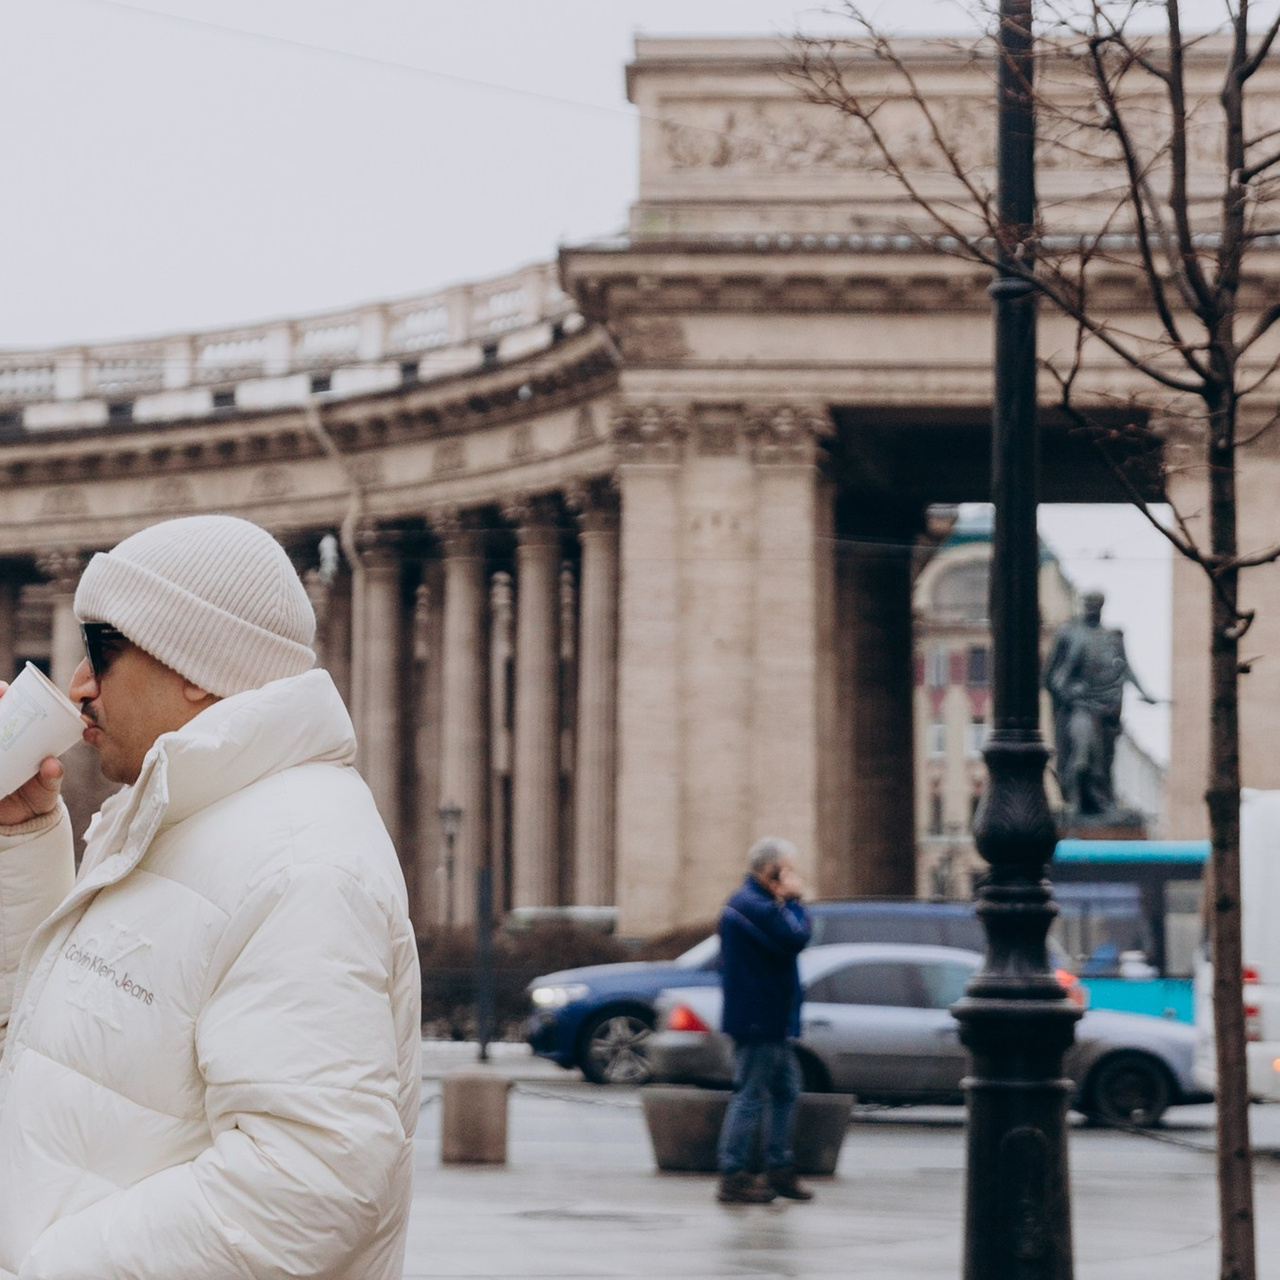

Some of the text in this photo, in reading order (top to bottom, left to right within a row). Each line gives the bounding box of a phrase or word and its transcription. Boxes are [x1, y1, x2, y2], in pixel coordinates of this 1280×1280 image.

[65, 943, 154, 1006] Calvin Klein Jeans
